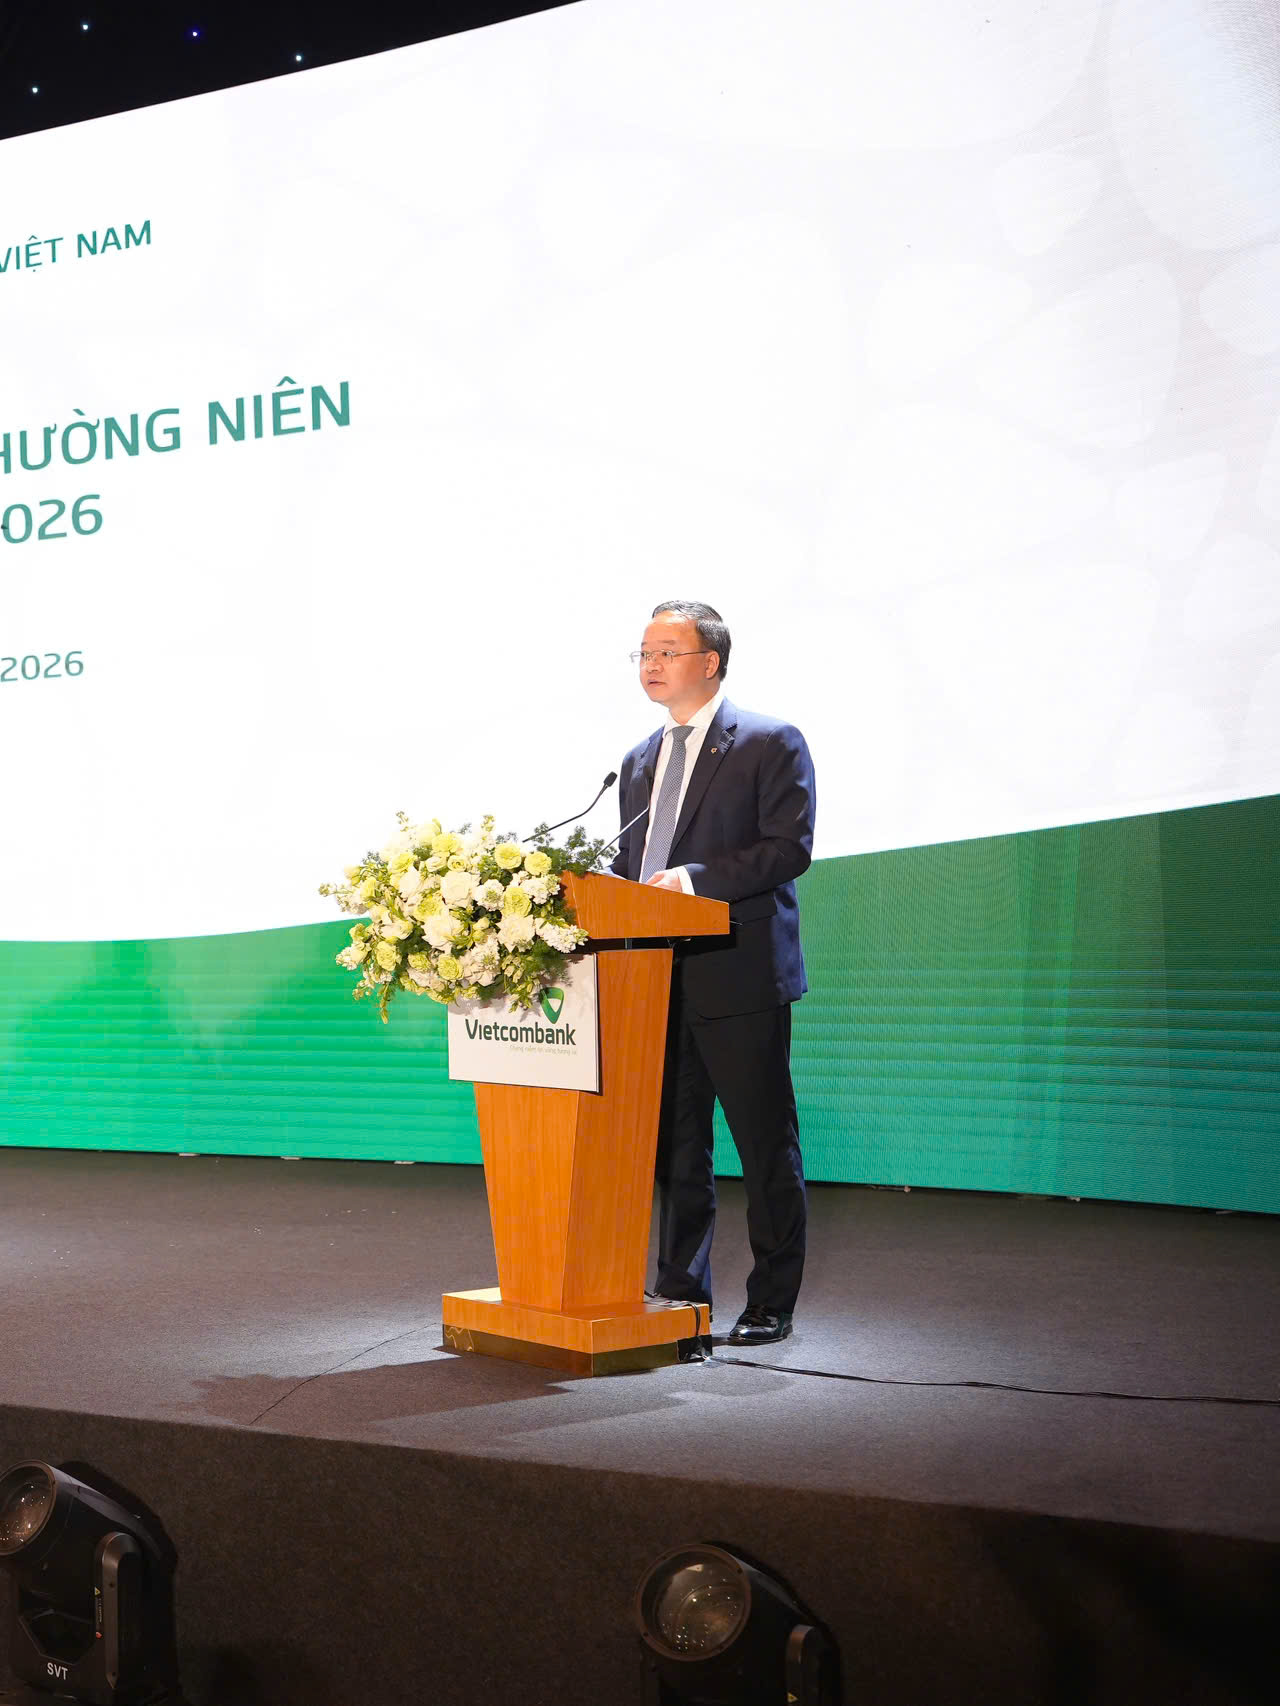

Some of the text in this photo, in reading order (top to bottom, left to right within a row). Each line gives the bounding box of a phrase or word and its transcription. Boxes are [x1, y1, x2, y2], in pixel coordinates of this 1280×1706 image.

[77, 220, 152, 258] NAM
[208, 376, 351, 446] NIÊN
[0, 651, 84, 683] 2026
[465, 1018, 577, 1046] Vietcombank
[47, 1661, 68, 1680] SVT
